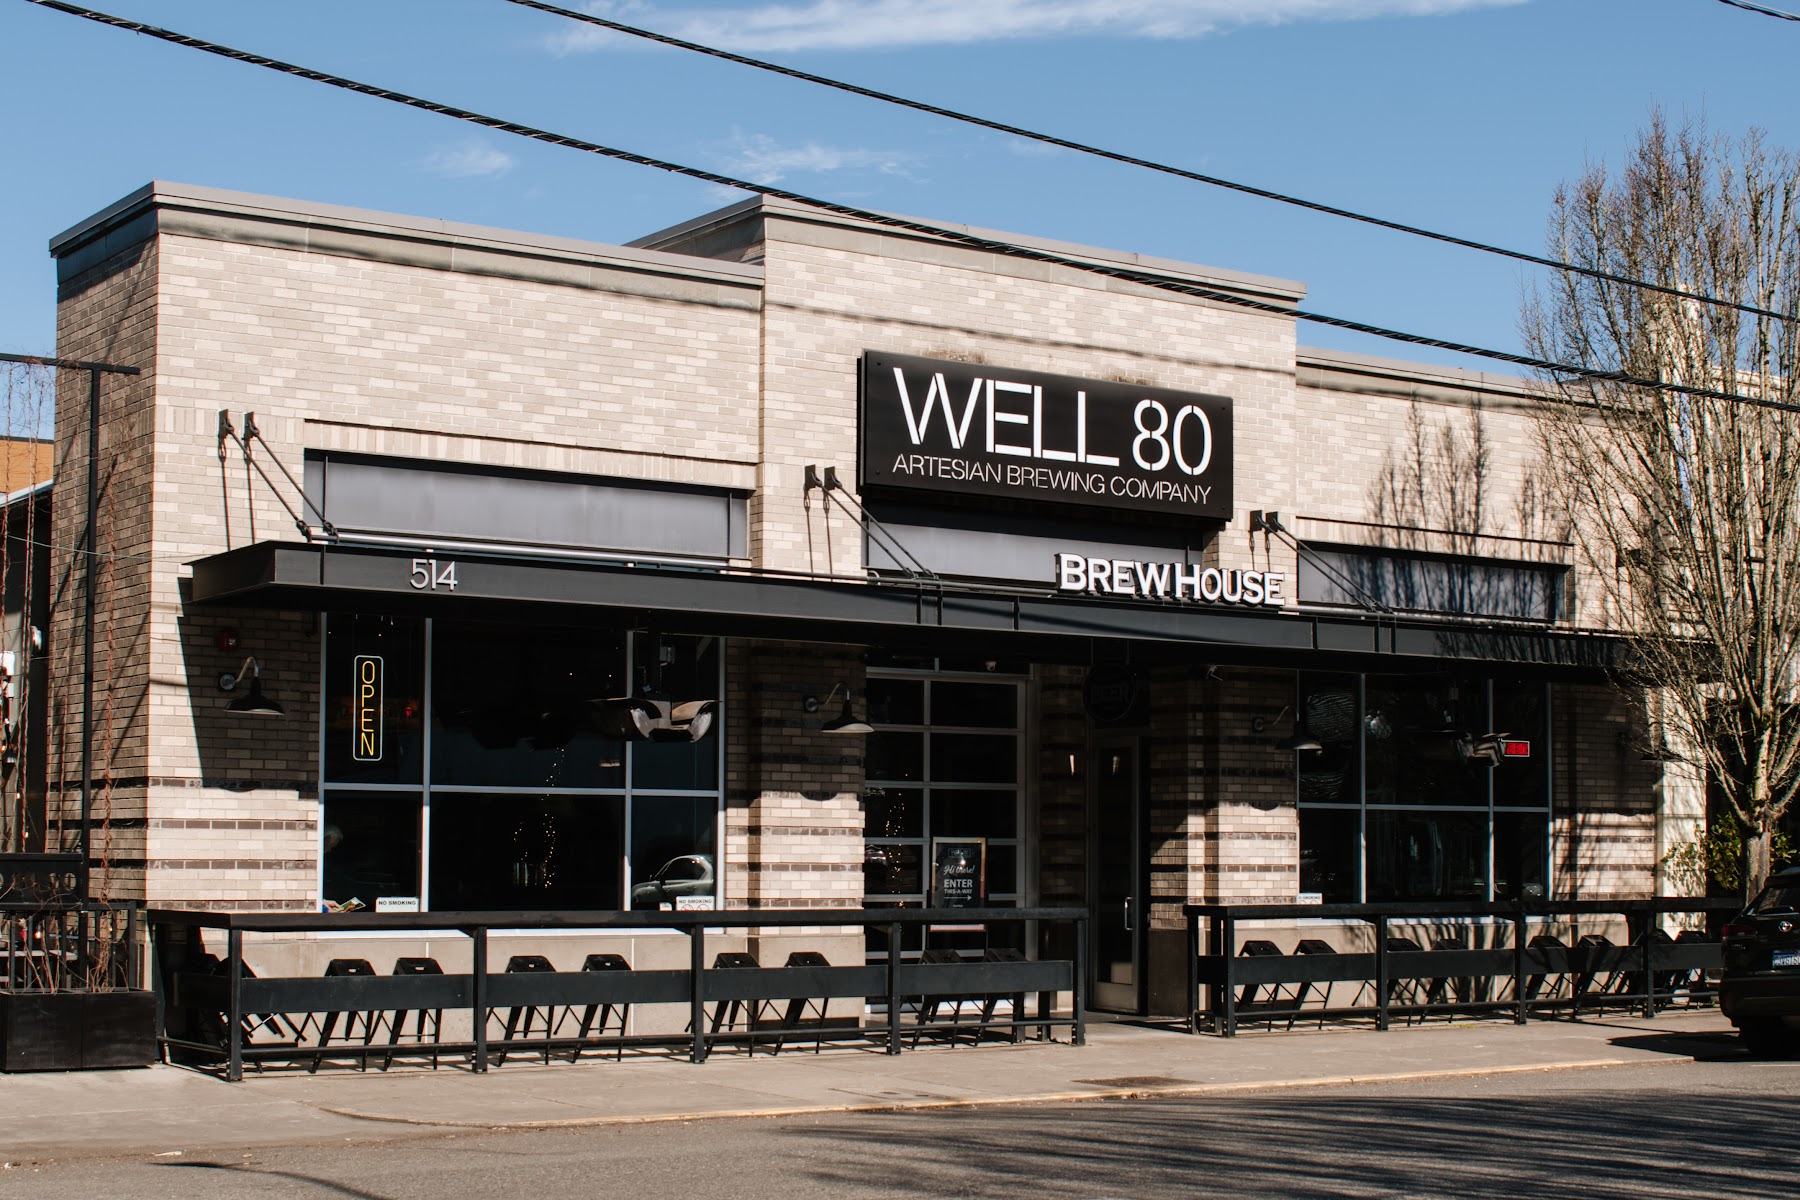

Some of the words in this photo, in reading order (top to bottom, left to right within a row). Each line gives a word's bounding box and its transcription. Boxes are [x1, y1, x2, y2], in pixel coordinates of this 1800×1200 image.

[892, 366, 1120, 467] WELL
[1132, 398, 1212, 476] 80
[892, 454, 1001, 484] ARTESIAN
[1006, 465, 1105, 495] BREWING
[1110, 476, 1212, 505] COMPANY
[410, 558, 459, 591] 514
[1056, 553, 1285, 607] BREWHOUSE
[360, 660, 376, 756] OPEN
[943, 878, 973, 888] ENTER
